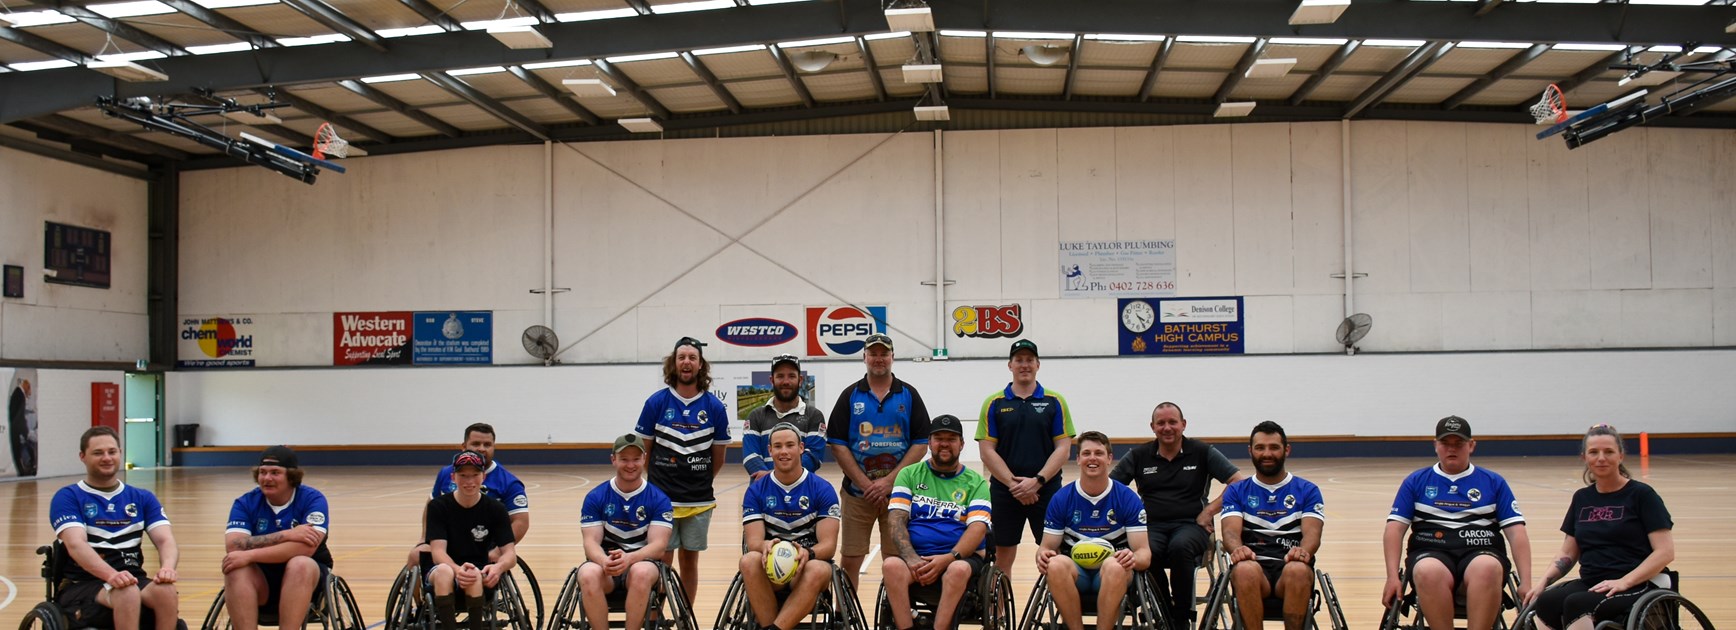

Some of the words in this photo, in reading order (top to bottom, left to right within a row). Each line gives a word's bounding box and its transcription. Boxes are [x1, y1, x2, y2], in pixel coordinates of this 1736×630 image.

[1059, 242, 1084, 251] LUKE
[1086, 241, 1122, 250] TAYLOR
[1124, 240, 1174, 249] PLUMBING
[1090, 281, 1107, 291] Ph:
[1109, 282, 1133, 291] 0402
[1136, 281, 1154, 290] 728
[1156, 281, 1174, 290] 636
[1191, 305, 1214, 313] Denison
[1214, 304, 1235, 314] College
[340, 314, 405, 331] Western
[952, 303, 1023, 338] 2BS
[181, 327, 217, 340] chem
[727, 325, 785, 336] WESTCO
[819, 323, 873, 336] PEPSI
[1164, 323, 1228, 333] BATHURST
[217, 335, 253, 348] world
[340, 331, 407, 347] Advocate
[1155, 333, 1184, 342] HIGH
[1188, 333, 1239, 342] CAMPUS
[344, 349, 371, 361] Supporting
[372, 348, 385, 359] Local
[1458, 529, 1495, 538] CARCOAR
[1466, 538, 1493, 546] HOTEL
